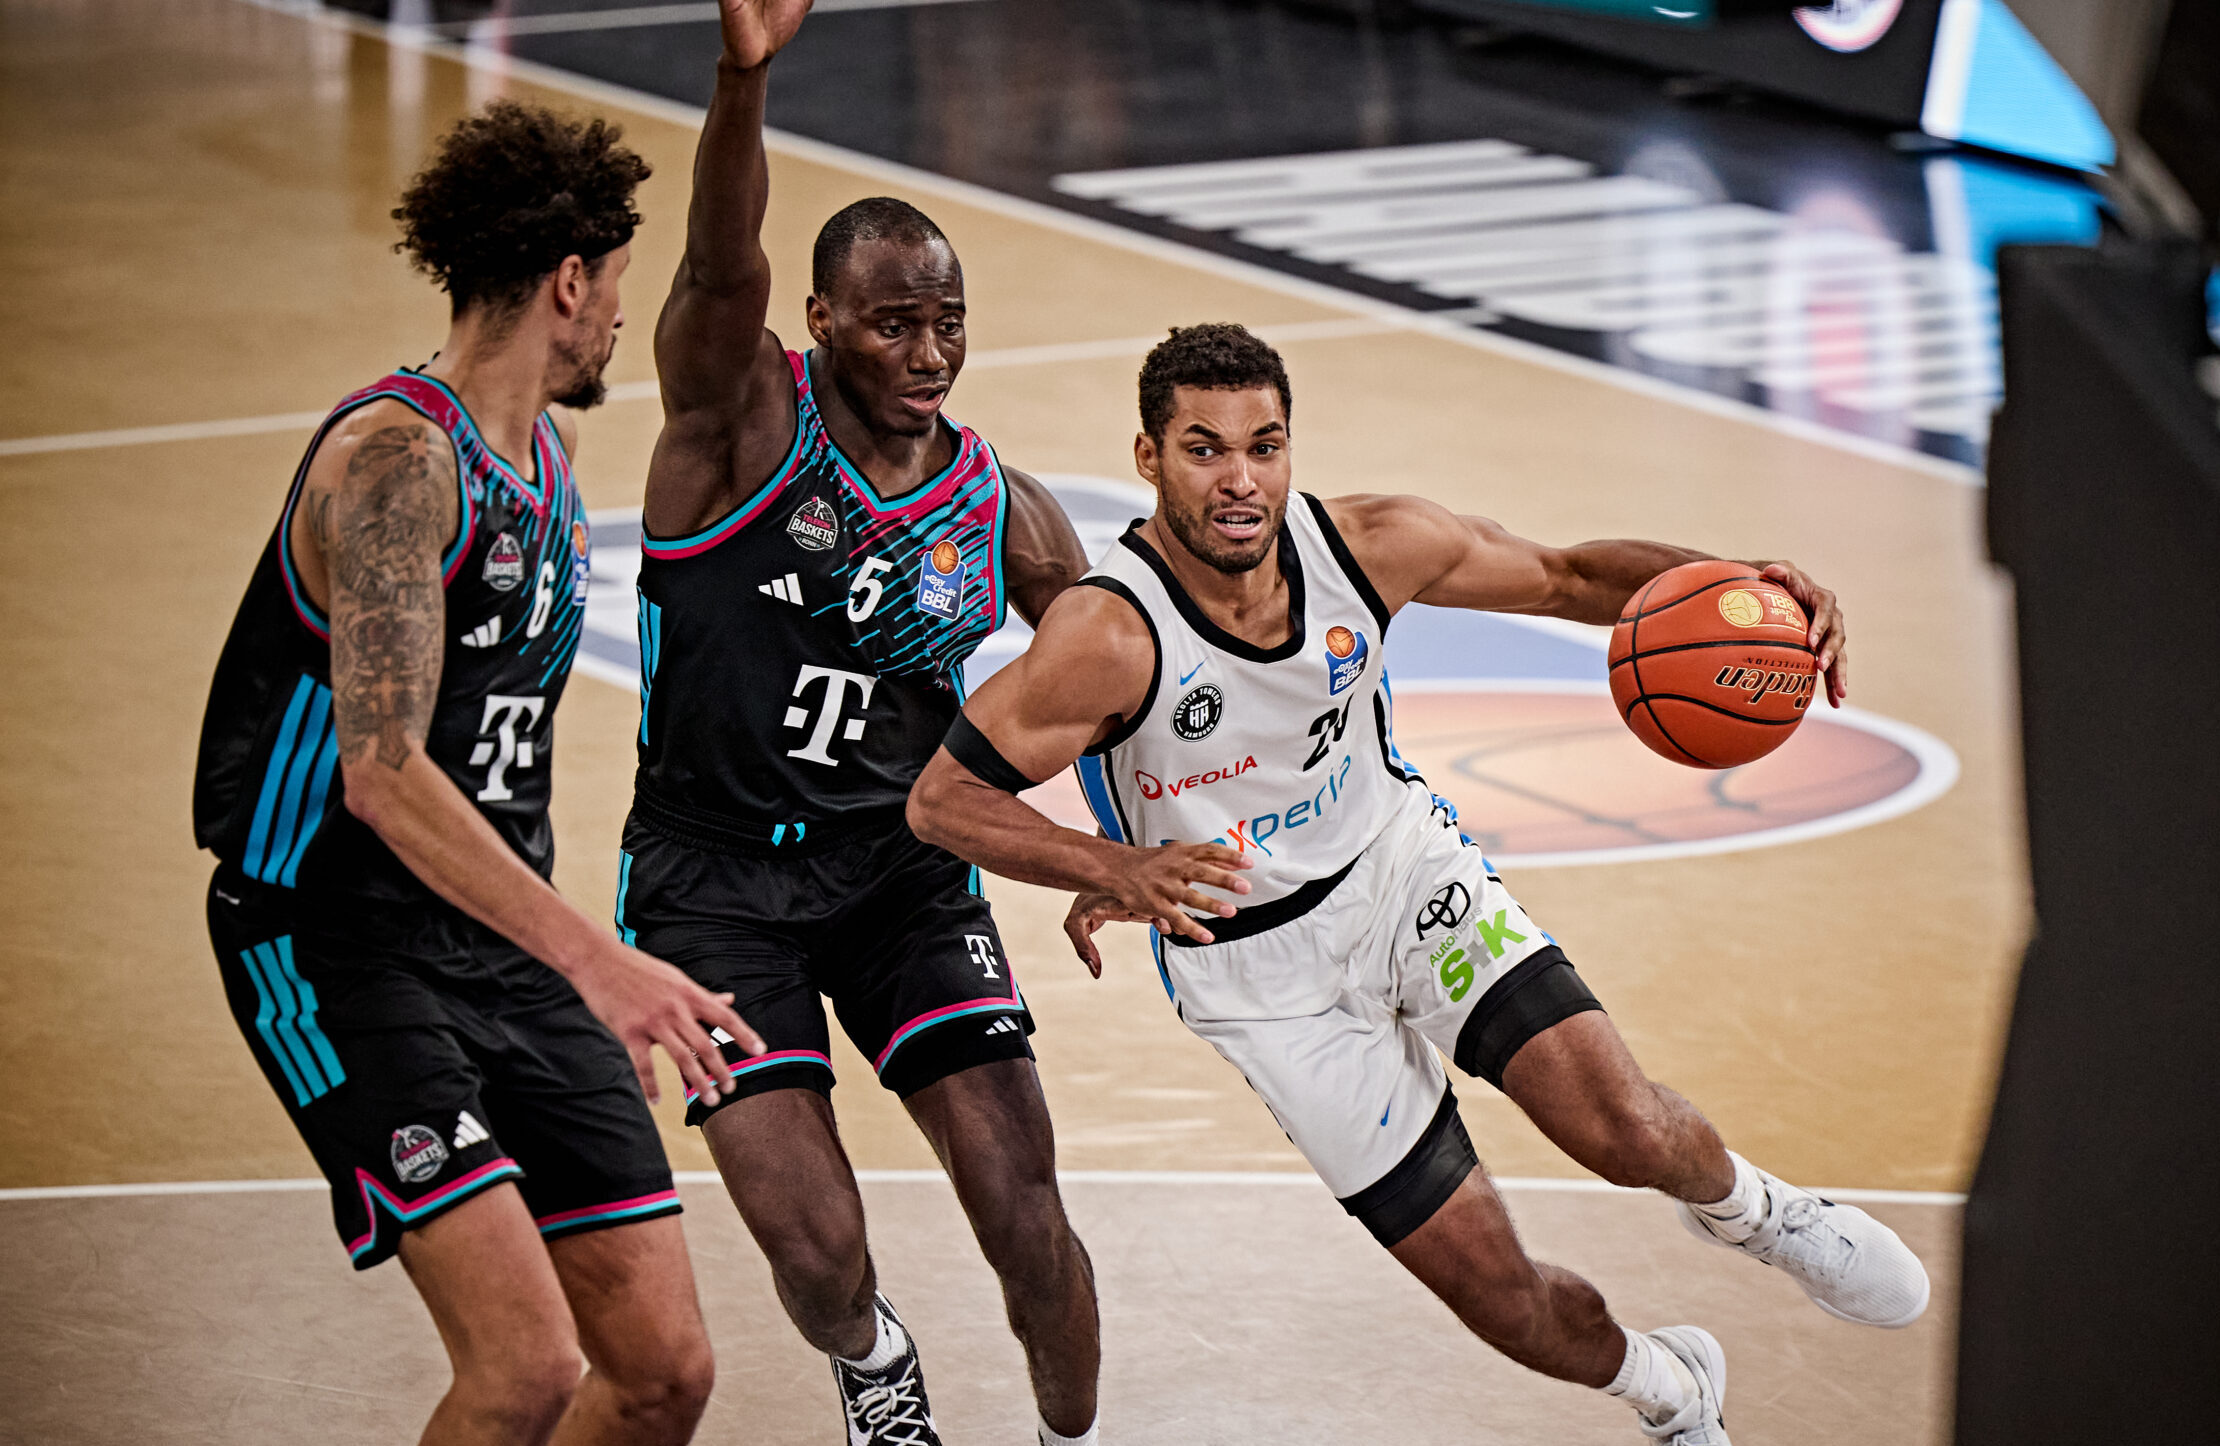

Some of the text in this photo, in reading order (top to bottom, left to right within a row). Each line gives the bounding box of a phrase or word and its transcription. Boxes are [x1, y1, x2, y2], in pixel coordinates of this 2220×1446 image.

[790, 518, 834, 544] BASKETS
[526, 560, 556, 639] 6
[847, 556, 893, 623] 5
[921, 589, 954, 614] BBL
[932, 584, 957, 598] Credit
[1763, 592, 1797, 613] BBL
[1333, 665, 1363, 691] BBL
[1713, 665, 1816, 710] Baden
[783, 664, 878, 767] T
[1174, 687, 1221, 720] VEOLIA TOWERS
[1168, 755, 1258, 797] VEOLIA
[1160, 754, 1351, 858] xperi
[964, 935, 1000, 979] T
[1429, 906, 1483, 968] Autohaus
[1440, 908, 1528, 1003] S+K
